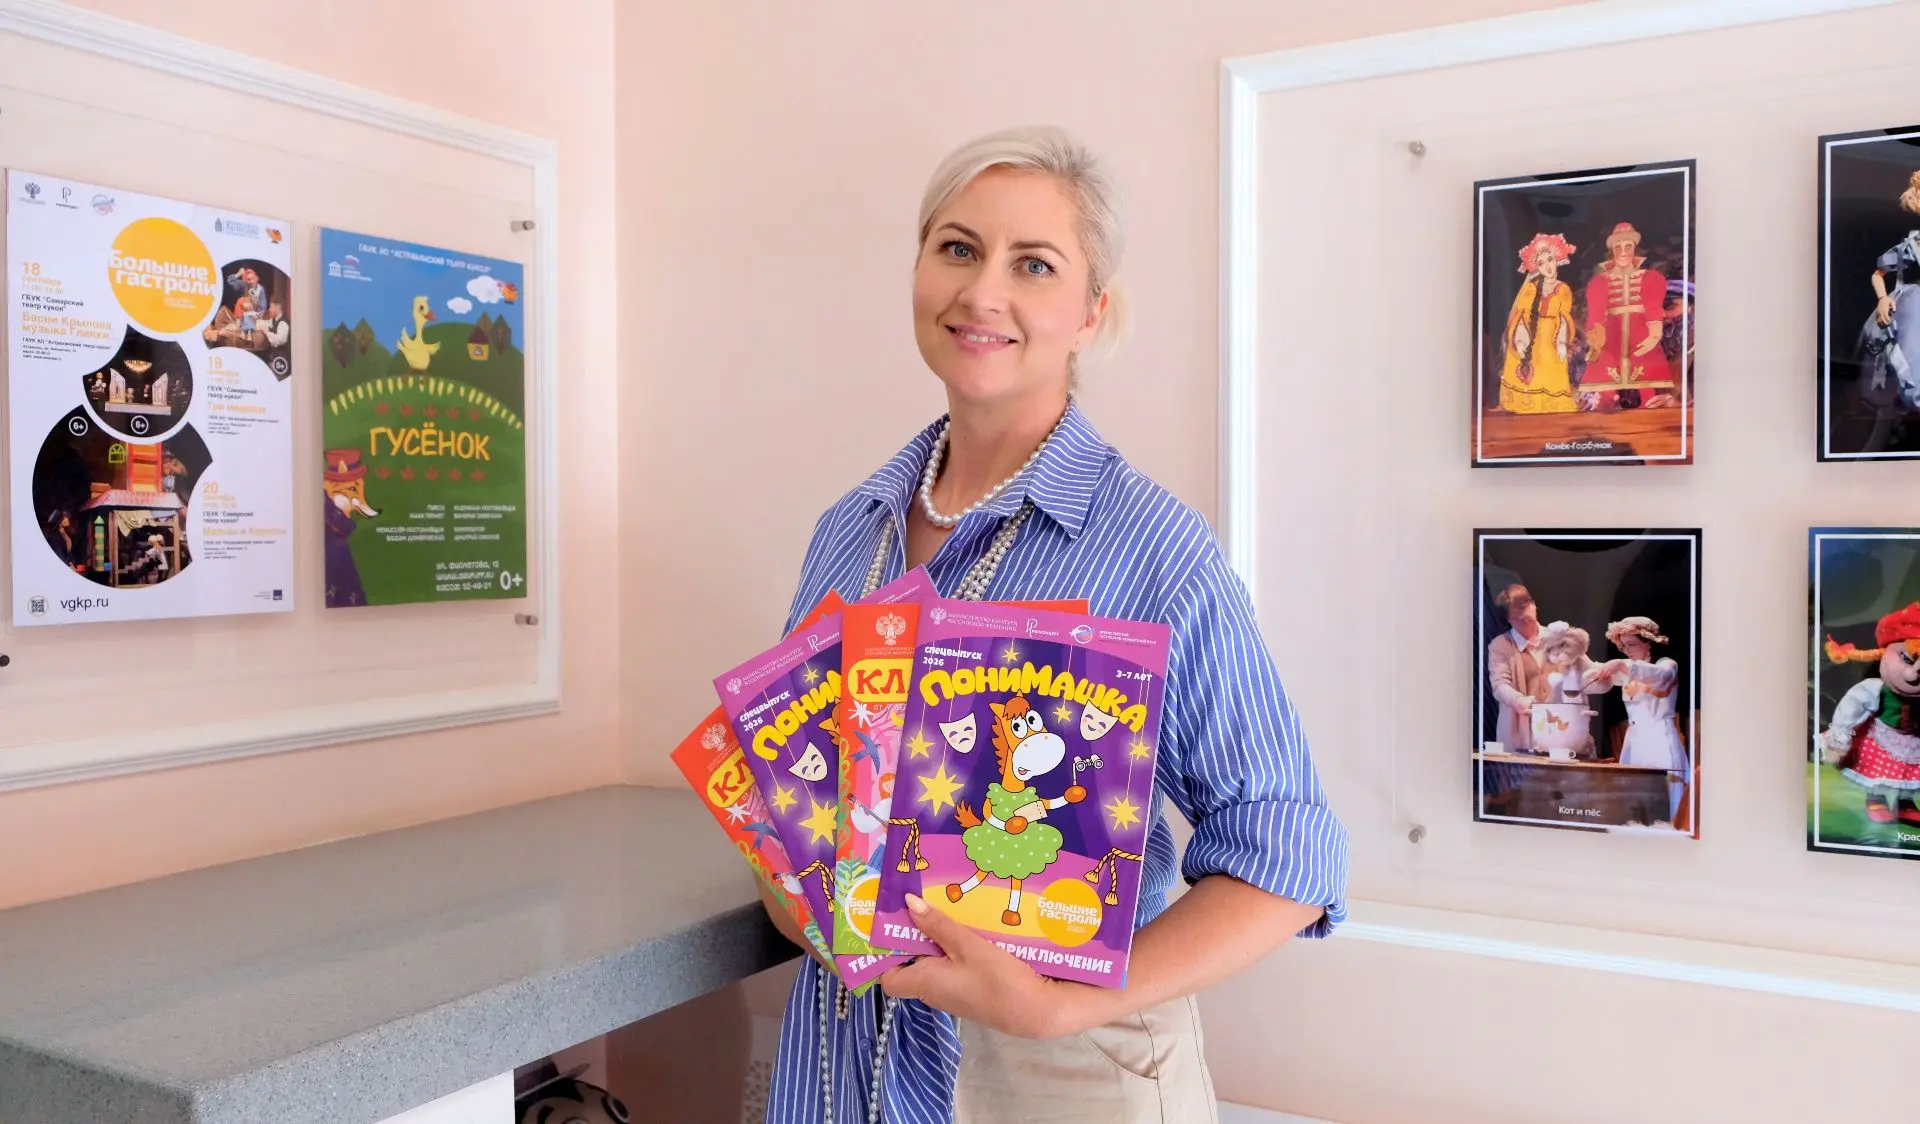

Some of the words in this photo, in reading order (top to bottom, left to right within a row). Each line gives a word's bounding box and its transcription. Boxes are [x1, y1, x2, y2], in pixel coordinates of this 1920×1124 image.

[22, 262, 41, 276] 18
[109, 249, 208, 280] Большие
[116, 269, 215, 296] гастроли
[21, 294, 41, 302] ГБУК
[22, 303, 41, 311] театр
[23, 312, 59, 324] Басни
[22, 324, 67, 336] музыка
[208, 356, 222, 369] 19
[73, 421, 84, 430] 6+
[135, 420, 146, 429] 6+
[369, 422, 491, 461] ГУСЁНОК
[203, 482, 219, 494] 20
[500, 570, 523, 590] 0+
[60, 596, 109, 612] vgkp.ru
[923, 657, 944, 666] 2026
[1116, 670, 1132, 679] 3-7
[919, 661, 1147, 733] ПОНИМАШКА
[743, 716, 763, 732] 2026
[1559, 805, 1575, 815] Кот
[1584, 808, 1601, 817] пёс
[1897, 832, 1920, 841] Крас
[1038, 896, 1098, 917] Большие
[1039, 908, 1101, 926] гастроли
